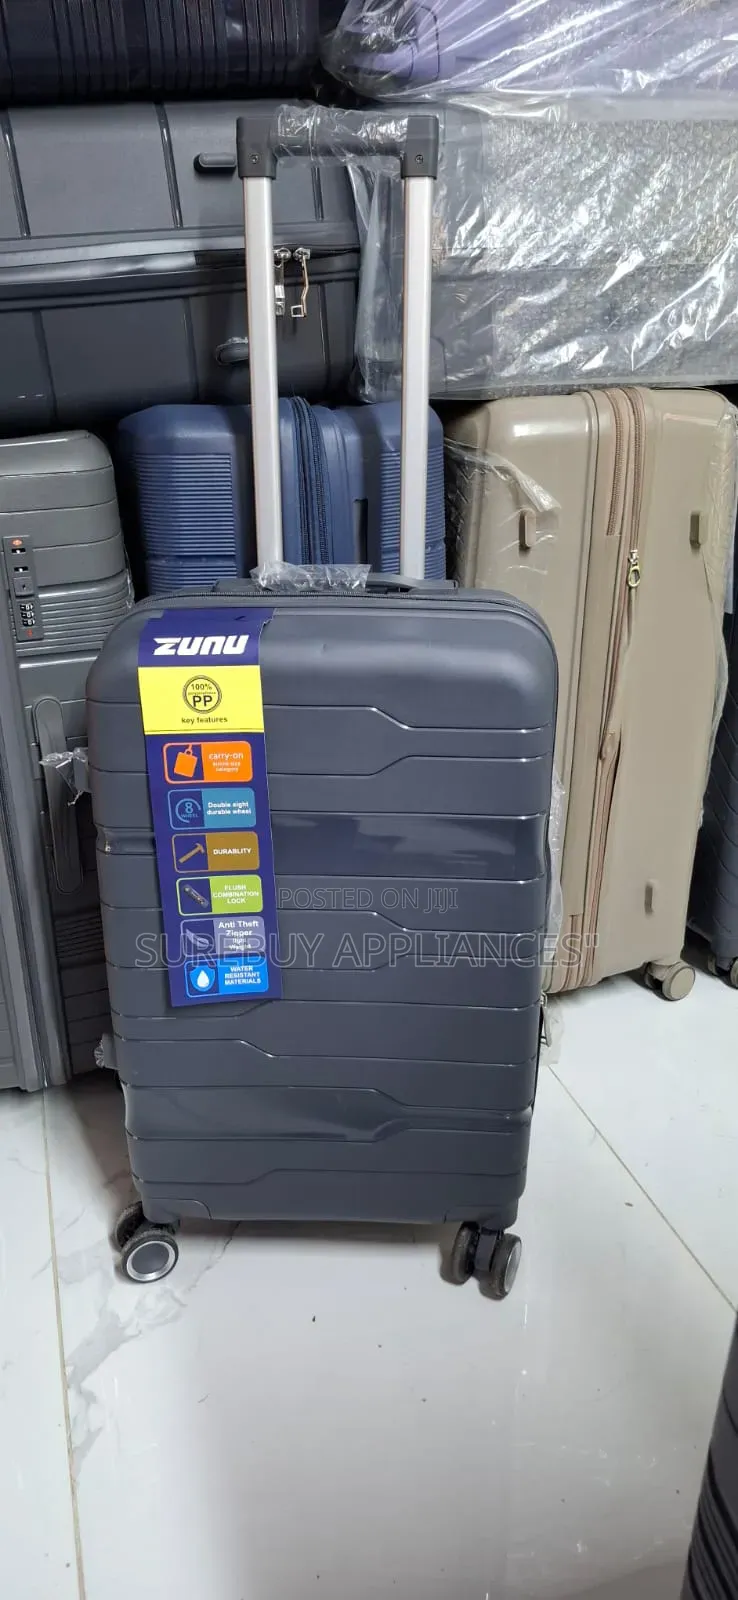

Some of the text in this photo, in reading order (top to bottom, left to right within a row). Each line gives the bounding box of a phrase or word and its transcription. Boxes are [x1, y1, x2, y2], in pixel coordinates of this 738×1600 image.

[190, 683, 213, 691] 100%
[192, 694, 213, 707] PP
[181, 716, 228, 725] key features
[208, 752, 244, 762] carry-on
[185, 802, 194, 814] 8
[218, 920, 259, 929] Anti Theft
